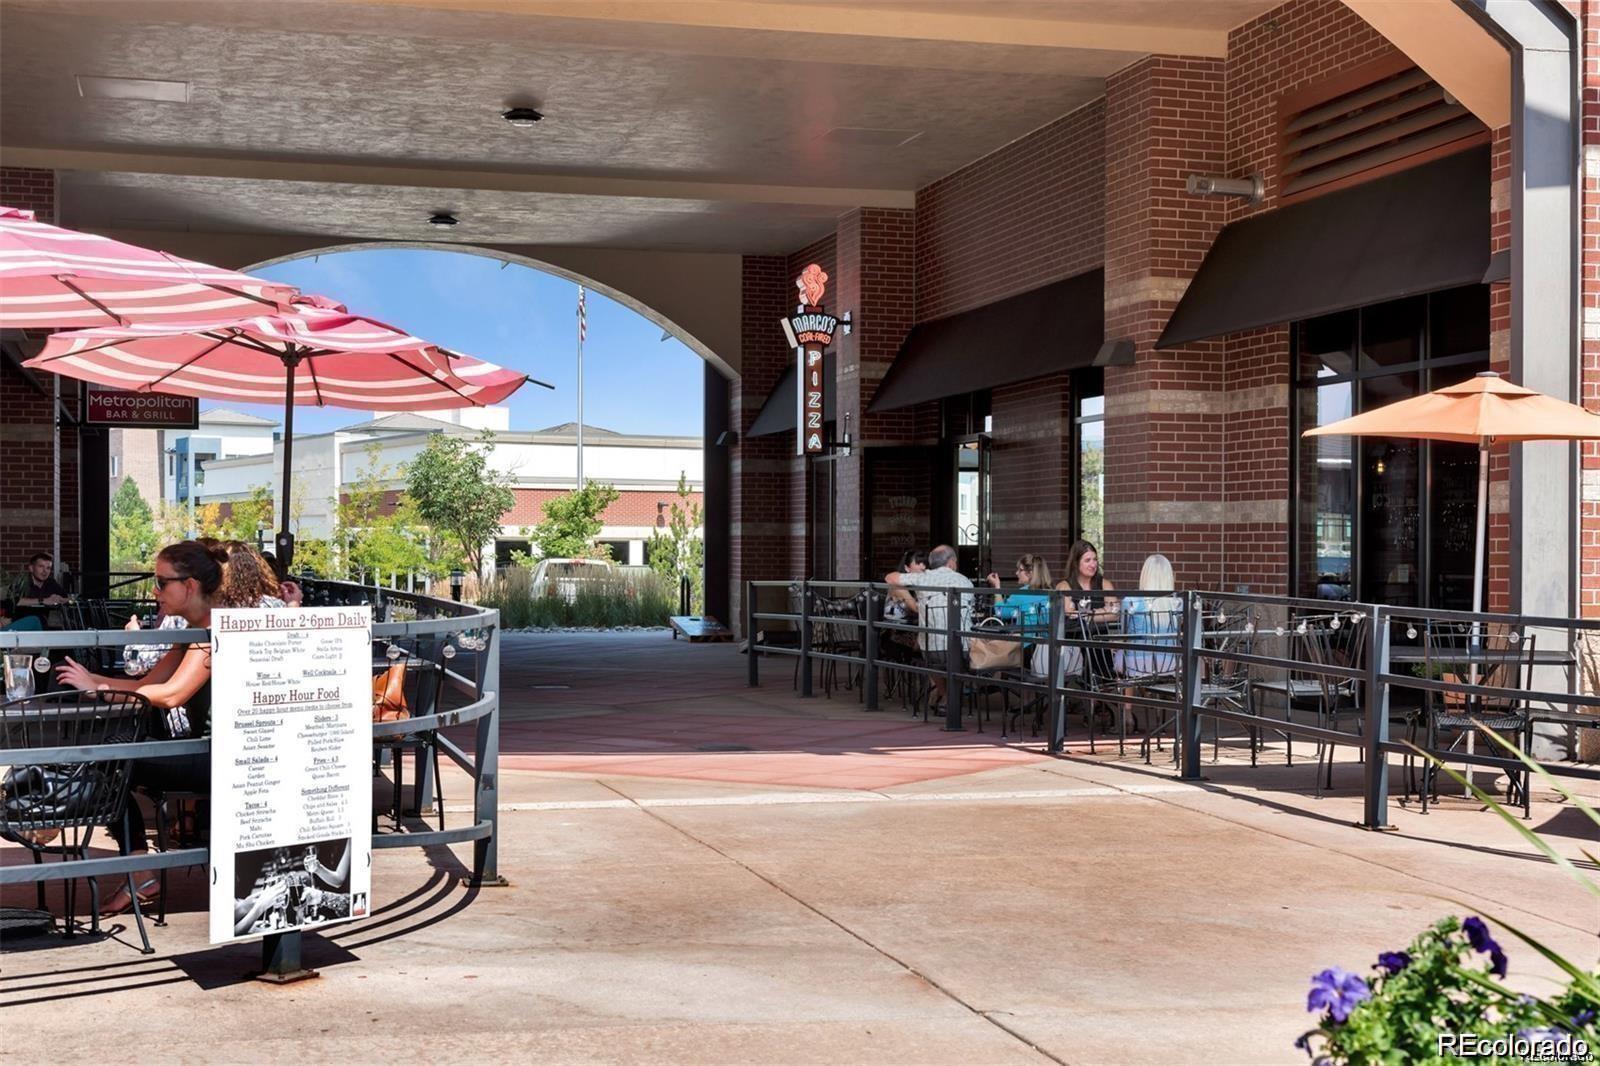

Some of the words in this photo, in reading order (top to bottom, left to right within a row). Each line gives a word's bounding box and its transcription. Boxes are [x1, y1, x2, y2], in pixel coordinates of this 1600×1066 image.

[792, 314, 836, 334] MARCO'S
[89, 395, 191, 409] Metropolitan
[808, 350, 822, 449] PIZZA
[106, 410, 128, 419] BAR
[131, 410, 139, 419] &
[143, 411, 175, 420] GRILL
[220, 615, 262, 631] Happy
[265, 614, 296, 628] Hour
[299, 613, 334, 629] 2-6pm
[337, 612, 367, 627] Daily
[253, 691, 287, 705] Happy
[289, 689, 315, 701] Hour
[317, 686, 340, 700] Food
[235, 757, 251, 766] Small
